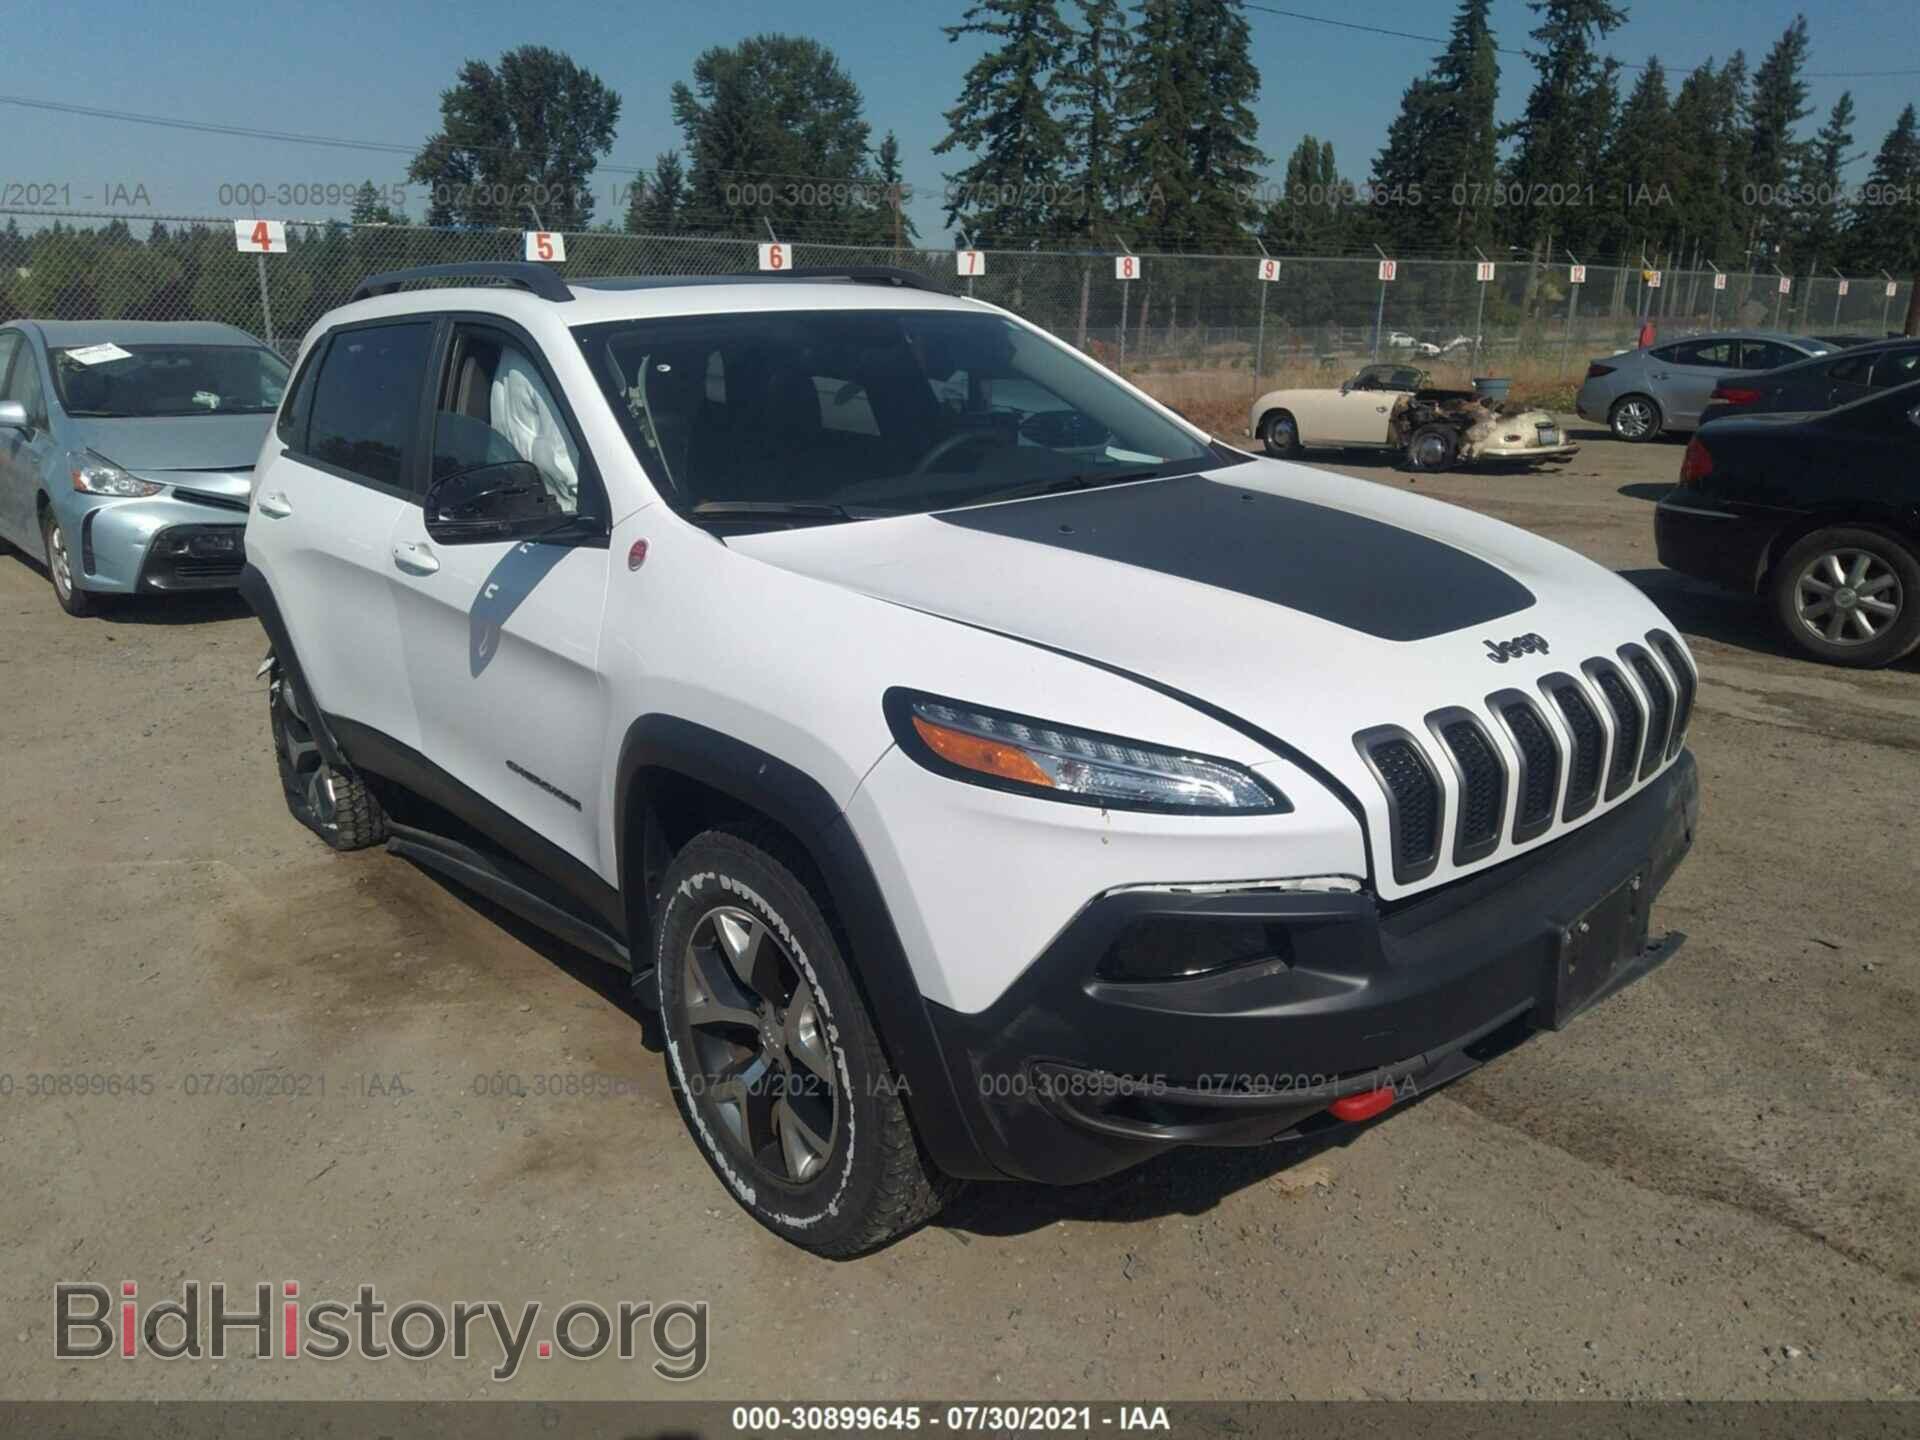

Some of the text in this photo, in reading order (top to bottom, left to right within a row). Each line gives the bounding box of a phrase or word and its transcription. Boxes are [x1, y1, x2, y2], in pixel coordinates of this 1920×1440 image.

[250, 221, 271, 251] 4
[536, 233, 553, 259] 5
[769, 245, 783, 268] 6
[966, 252, 977, 274] 7
[1123, 258, 1134, 277] 8
[1265, 261, 1274, 278] 9
[1383, 262, 1393, 279] 10
[1573, 266, 1584, 281] 12
